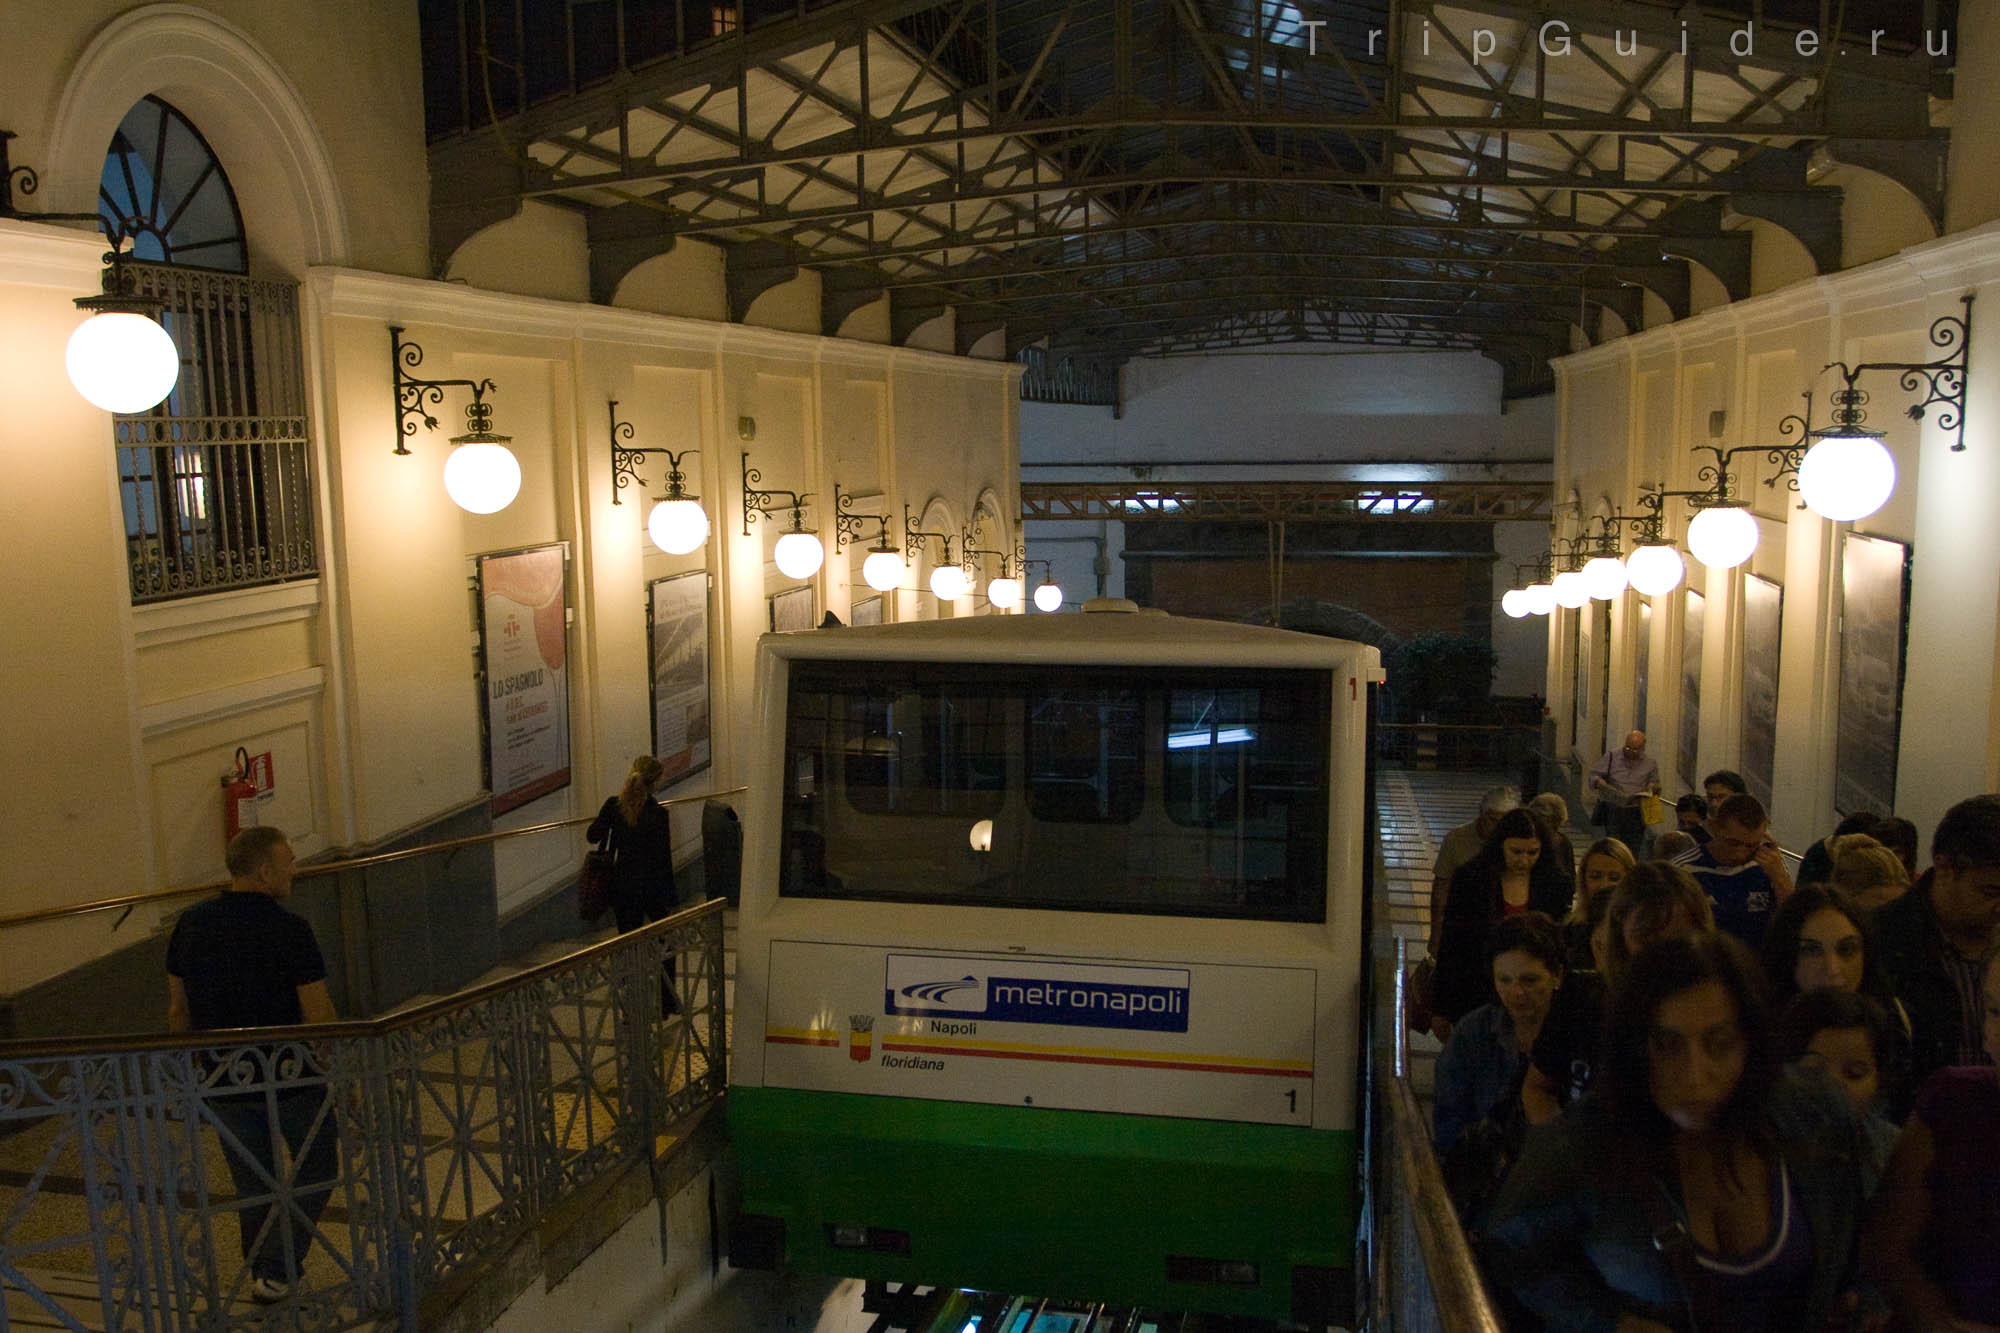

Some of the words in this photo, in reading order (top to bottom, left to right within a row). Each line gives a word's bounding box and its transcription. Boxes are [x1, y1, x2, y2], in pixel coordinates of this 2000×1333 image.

[504, 668, 544, 695] SPAGNOLO
[1349, 677, 1356, 701] 1
[995, 983, 1181, 1015] metronapoli
[930, 1019, 977, 1036] Napoli
[880, 1054, 945, 1071] floridiana
[1284, 1088, 1296, 1113] 1
